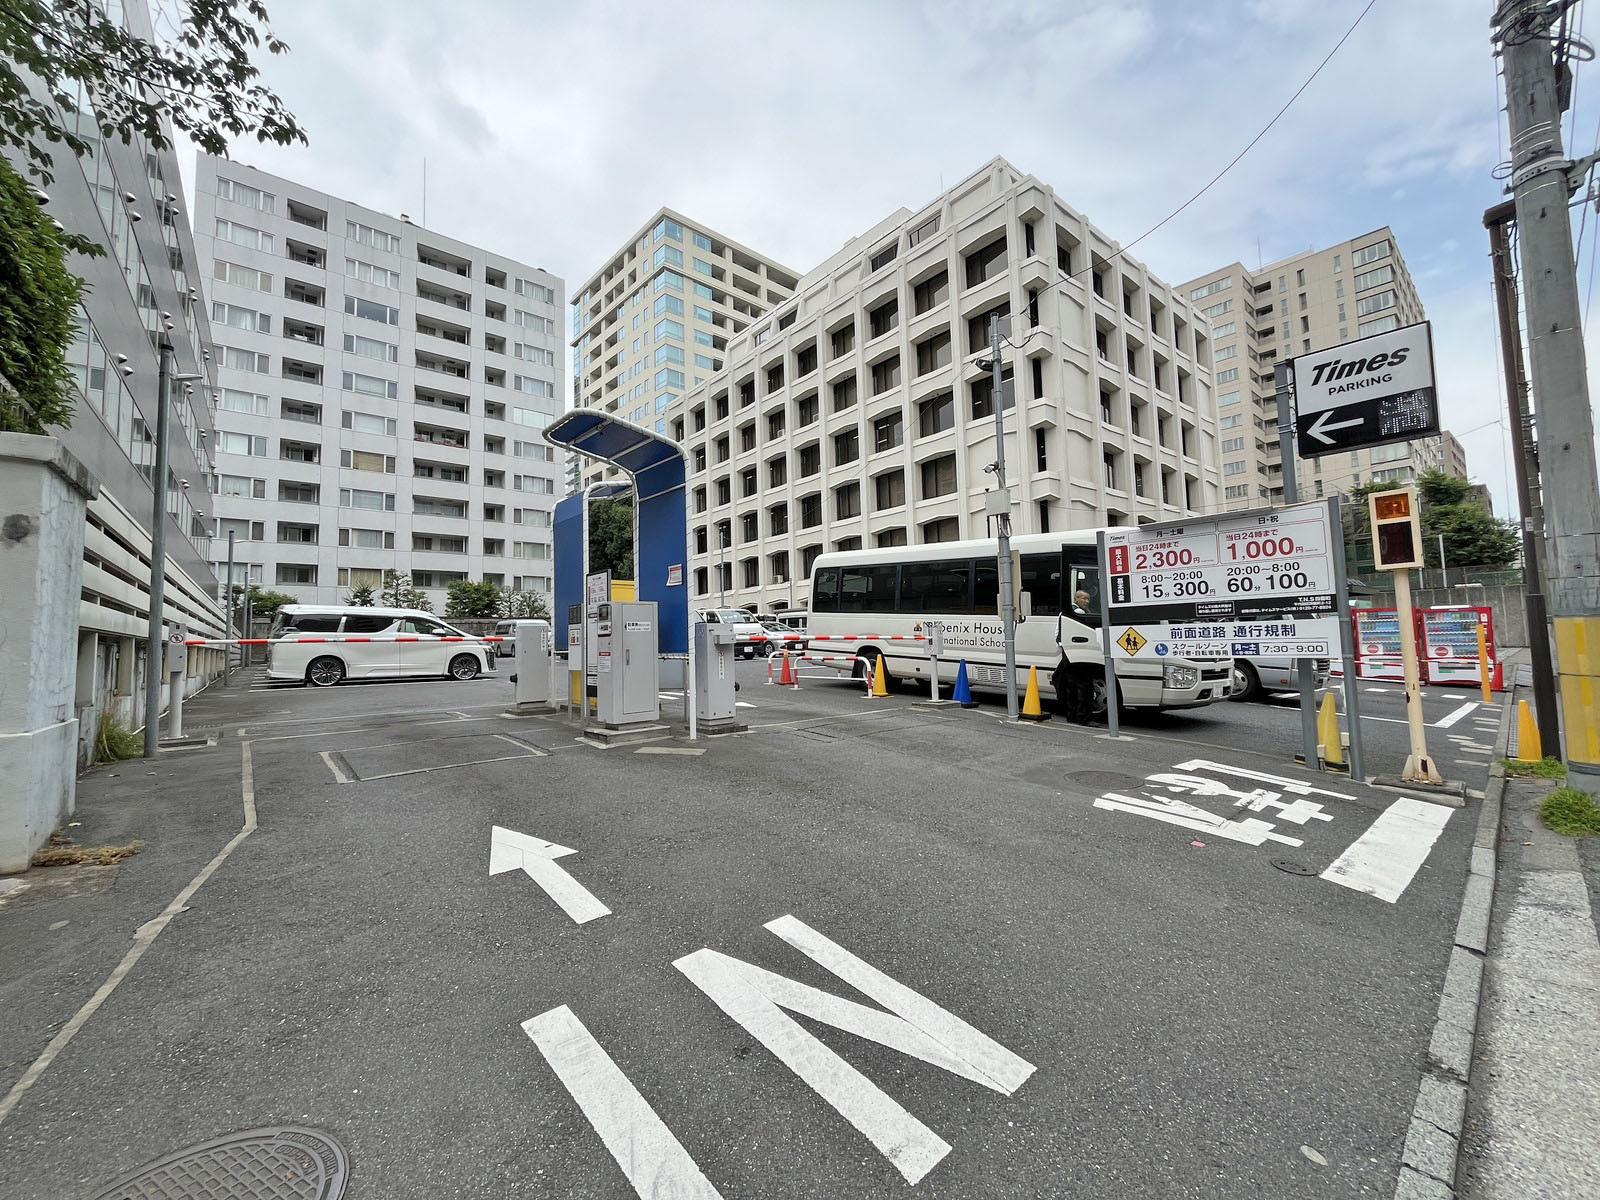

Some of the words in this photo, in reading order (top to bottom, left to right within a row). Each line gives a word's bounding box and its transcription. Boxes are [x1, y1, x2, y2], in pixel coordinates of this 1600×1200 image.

[1311, 347, 1410, 386] Times
[1328, 373, 1393, 396] PARKING
[1225, 529, 1279, 542] 当日24時まで
[1135, 541, 1180, 552] 当日24時まで
[942, 622, 970, 633] oenix
[974, 622, 1004, 635] Hous
[1170, 626, 1226, 639] 前面道路
[1233, 624, 1296, 638] 通行規制
[943, 636, 978, 646] national
[979, 637, 1006, 648] Schoo
[521, 914, 1037, 1200] IN
